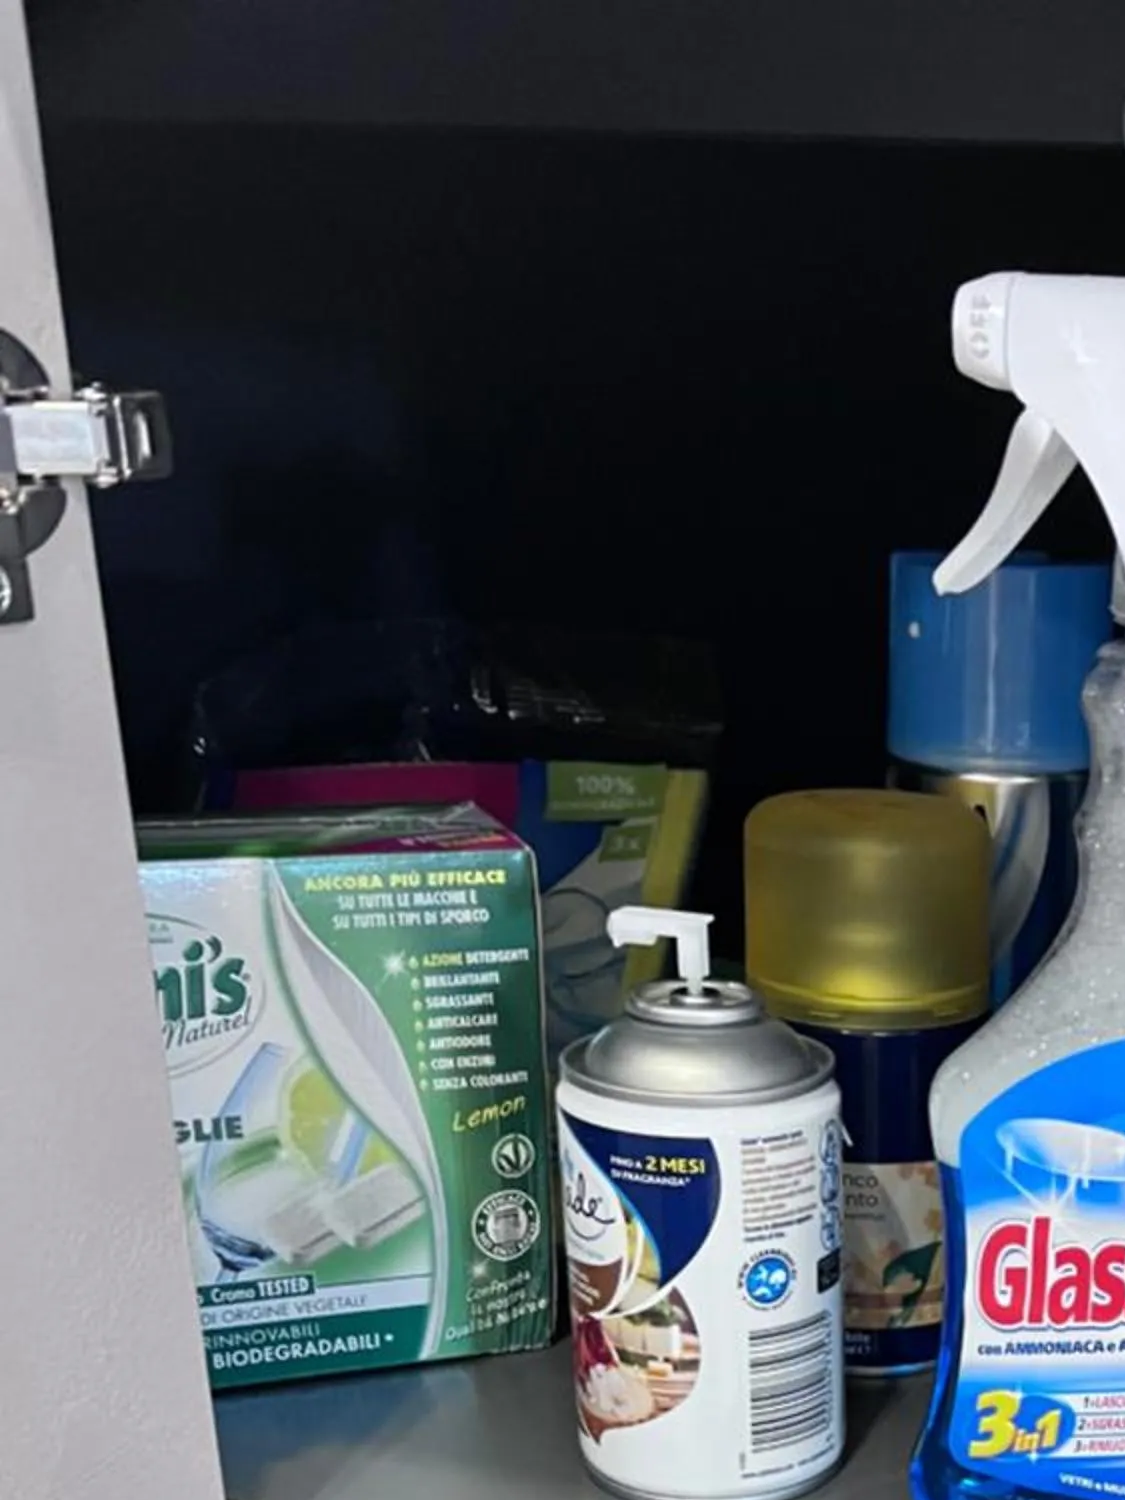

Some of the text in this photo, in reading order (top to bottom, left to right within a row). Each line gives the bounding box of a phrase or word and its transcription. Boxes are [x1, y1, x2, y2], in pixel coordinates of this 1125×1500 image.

[576, 775, 635, 797] 100%
[304, 869, 506, 892] ANCORA PIÙ EFFICACE
[338, 895, 354, 910] SU
[357, 893, 394, 909] TUTTE
[397, 893, 411, 908] LE
[413, 891, 467, 907] MACCHIE
[332, 908, 490, 930] SU TUTTI I TIPI DI SPORCO
[422, 949, 529, 967] AZIONE DETERGENTE
[424, 972, 499, 988] BRILLANTANTE
[425, 993, 494, 1009] SGRASSANTE
[161, 995, 252, 1050] Naturel
[427, 1014, 498, 1030] ANTICALCARE
[429, 1035, 492, 1050] ANTIODORE
[431, 1056, 454, 1070] CON
[433, 1071, 528, 1091] SENZA COLORANTI
[453, 1095, 526, 1133] Lemon
[645, 1156, 660, 1172] 2
[661, 1157, 706, 1175] MESI
[210, 1285, 256, 1303] Cromo
[258, 1276, 310, 1298] TESTED
[222, 1304, 289, 1324] ORIGINE
[293, 1294, 368, 1315] VEGETALE
[212, 1332, 381, 1370] BIODEGRADABILI
[977, 1343, 1001, 1356] con
[1004, 1339, 1103, 1357] AMMONIACA
[1106, 1342, 1117, 1353] e
[1059, 1472, 1094, 1490] VETRI
